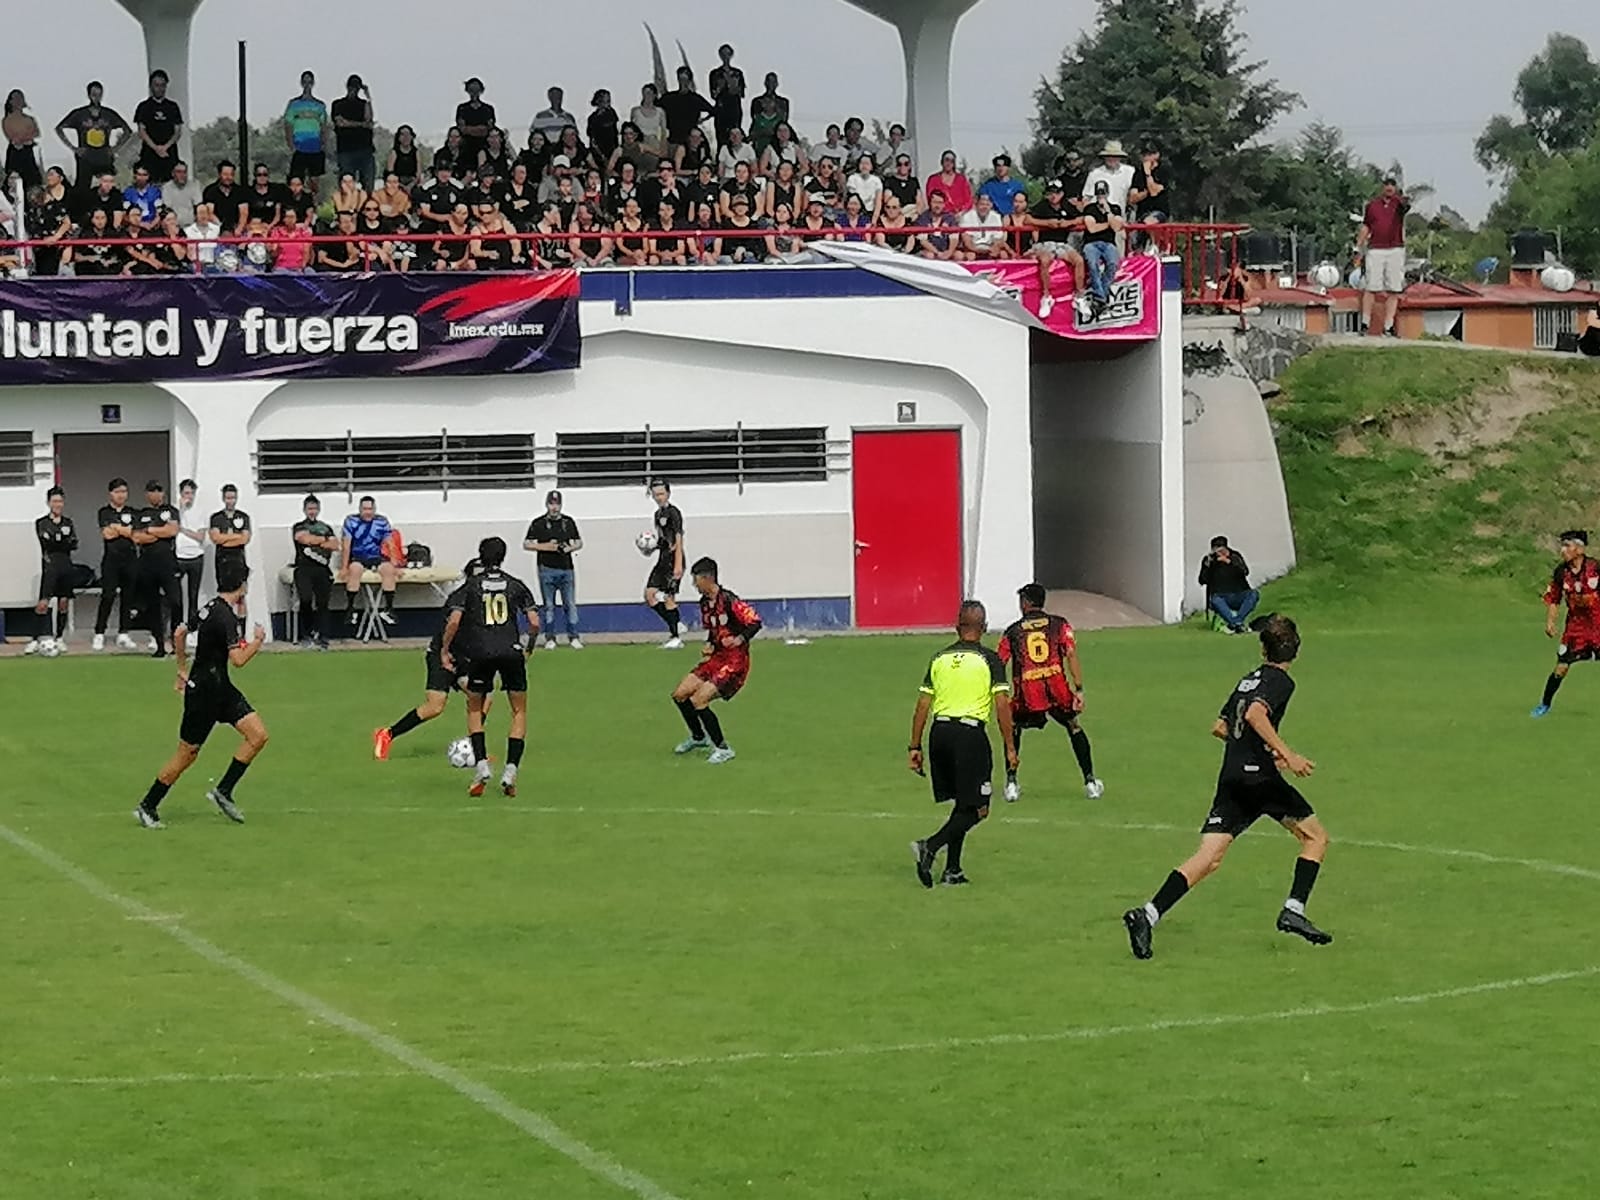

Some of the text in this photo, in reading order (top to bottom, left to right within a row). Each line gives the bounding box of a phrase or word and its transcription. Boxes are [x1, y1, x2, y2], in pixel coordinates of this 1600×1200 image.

[1, 307, 418, 366] luntad y fuerza
[482, 591, 509, 625] 10
[1026, 631, 1049, 663] 6
